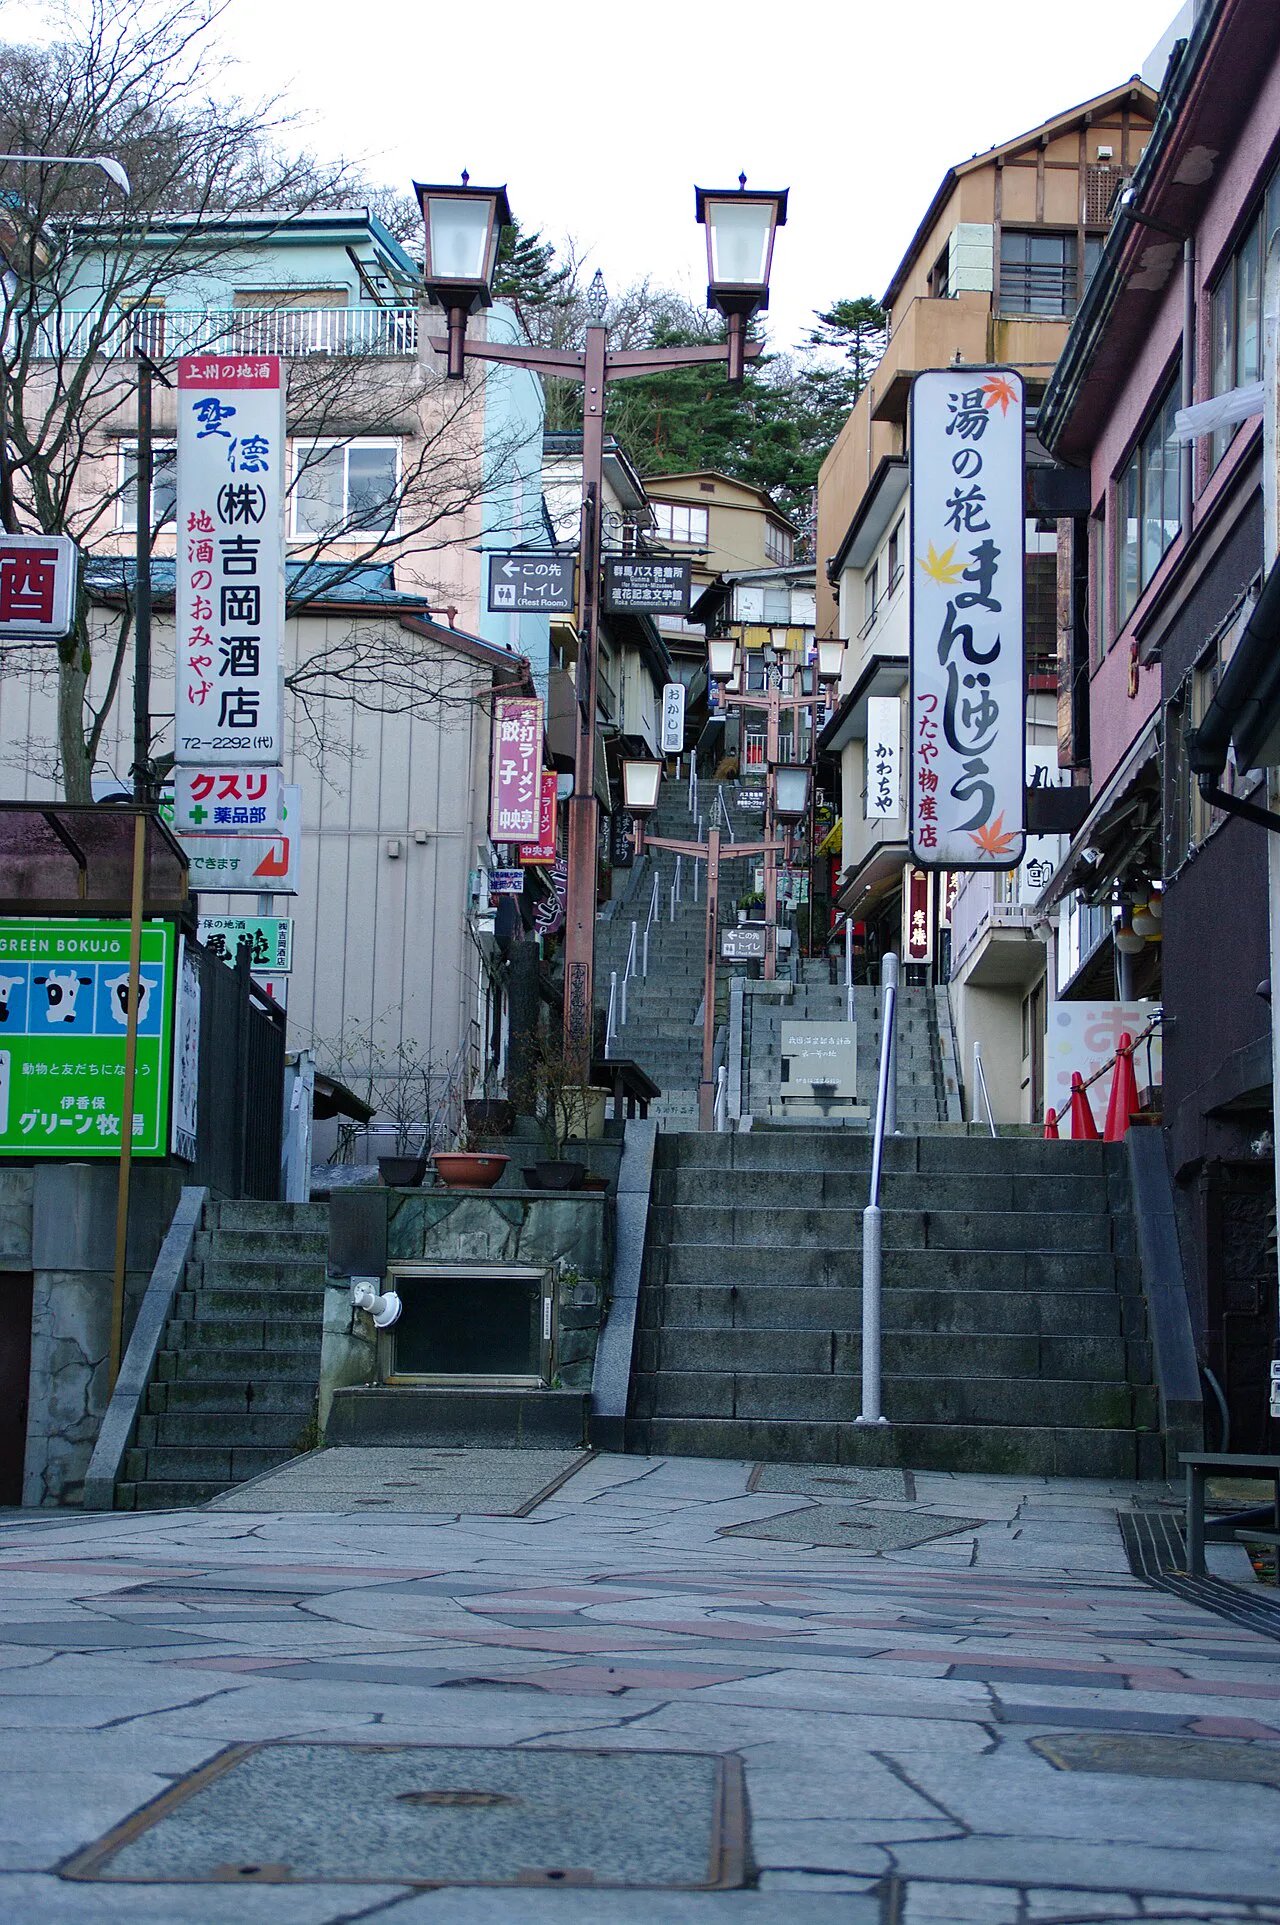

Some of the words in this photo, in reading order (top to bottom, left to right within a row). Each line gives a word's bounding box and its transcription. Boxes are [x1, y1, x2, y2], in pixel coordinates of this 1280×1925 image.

[185, 362, 270, 380] 上州の地酒
[522, 564, 562, 577] この先
[613, 565, 684, 579] 群馬バス発着所
[522, 582, 563, 596] トイレ
[187, 508, 215, 706] 地酒のおみやげ
[517, 599, 542, 607] (Rest
[543, 599, 568, 607] Room)
[936, 386, 1003, 833] 湯の花まんじゅう
[666, 689, 680, 746] おかし屋
[500, 719, 519, 785] 餃子
[518, 710, 535, 803] 手打ラーメン
[873, 742, 894, 814] かわちや
[916, 693, 939, 848] つたや物産店
[189, 773, 268, 801] クスリ
[213, 806, 267, 824] 薬品部
[500, 808, 533, 830] 中央亭
[522, 846, 554, 857] 中央亭
[0, 938, 49, 952] GREEN
[738, 932, 760, 940] この先
[738, 942, 761, 951] トイレ
[60, 1096, 106, 1110] 伊香保
